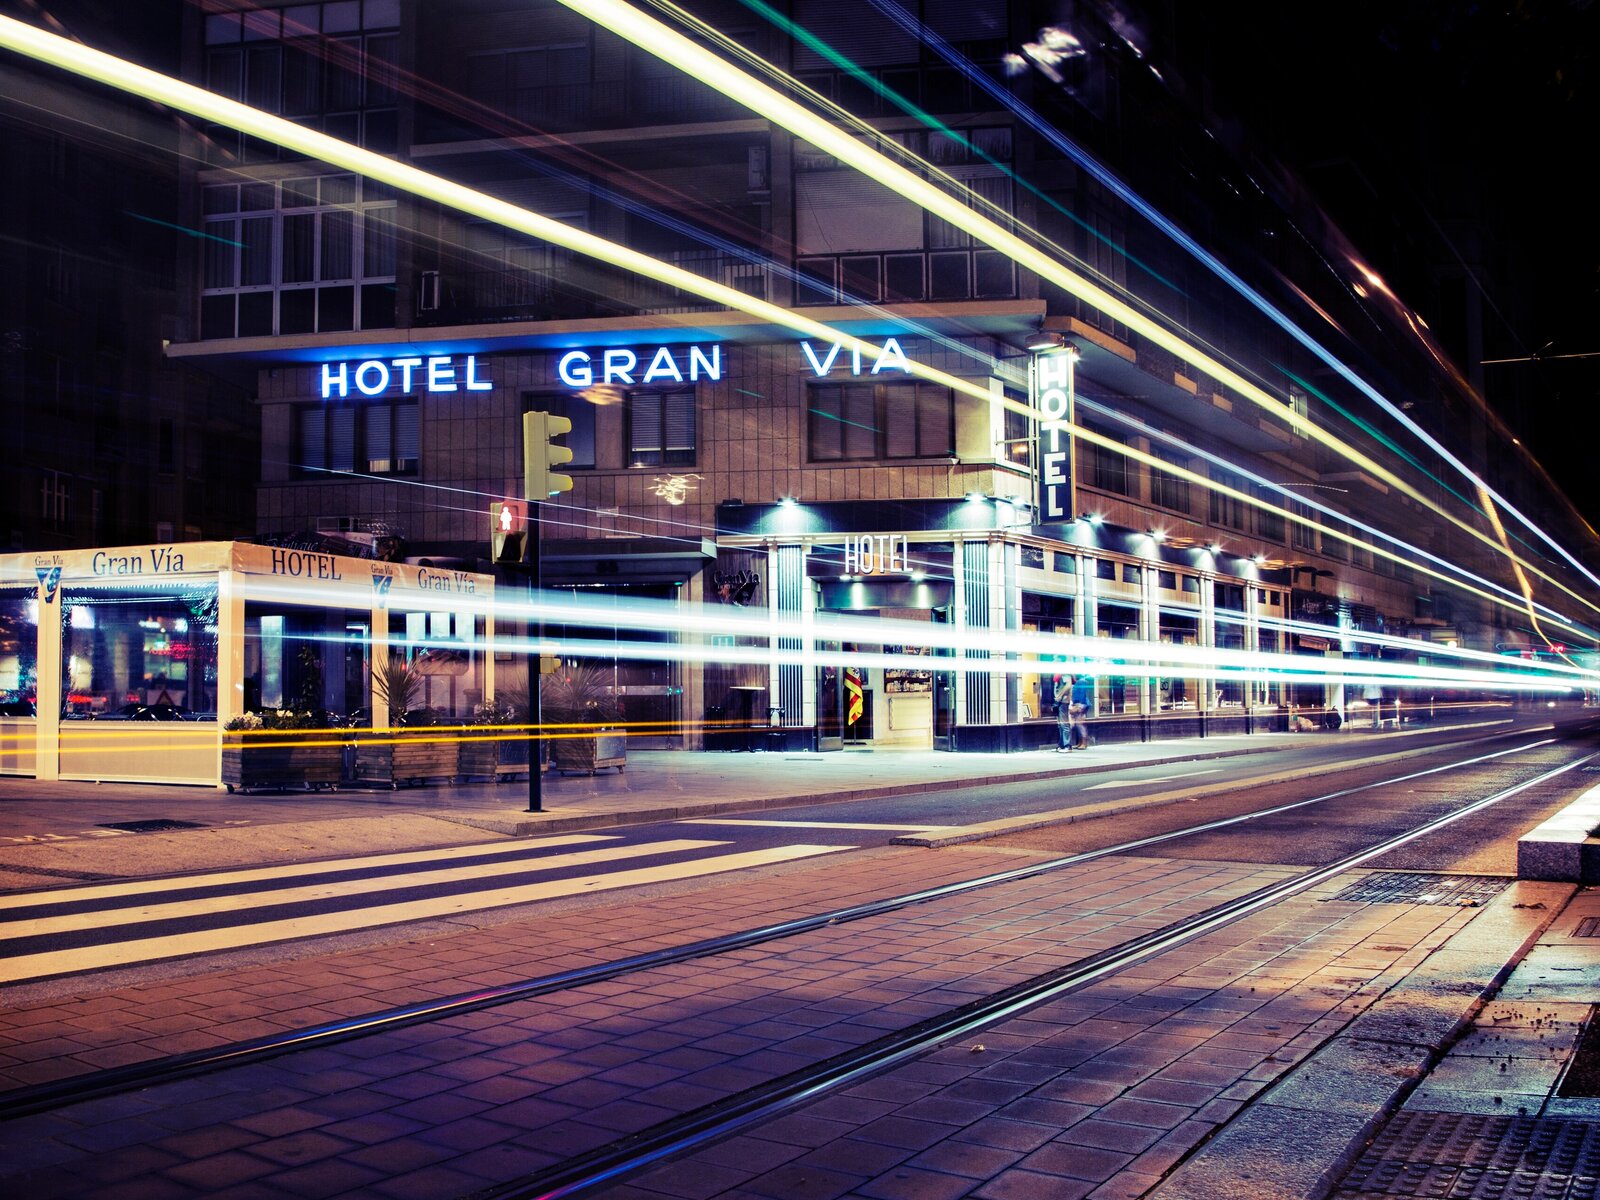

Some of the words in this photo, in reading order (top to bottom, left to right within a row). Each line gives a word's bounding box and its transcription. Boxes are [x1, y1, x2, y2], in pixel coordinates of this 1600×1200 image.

[321, 355, 493, 399] HOTEL
[558, 345, 721, 387] GRAN
[801, 337, 913, 377] VIA
[1038, 353, 1068, 517] HOTEL
[35, 556, 51, 566] Gran
[93, 551, 142, 576] Gran
[150, 547, 184, 573] Vía
[271, 549, 342, 581] HOTEL
[371, 564, 384, 574] Gran
[845, 534, 914, 574] HOTEL
[418, 568, 451, 591] Gran
[454, 573, 476, 593] Vía
